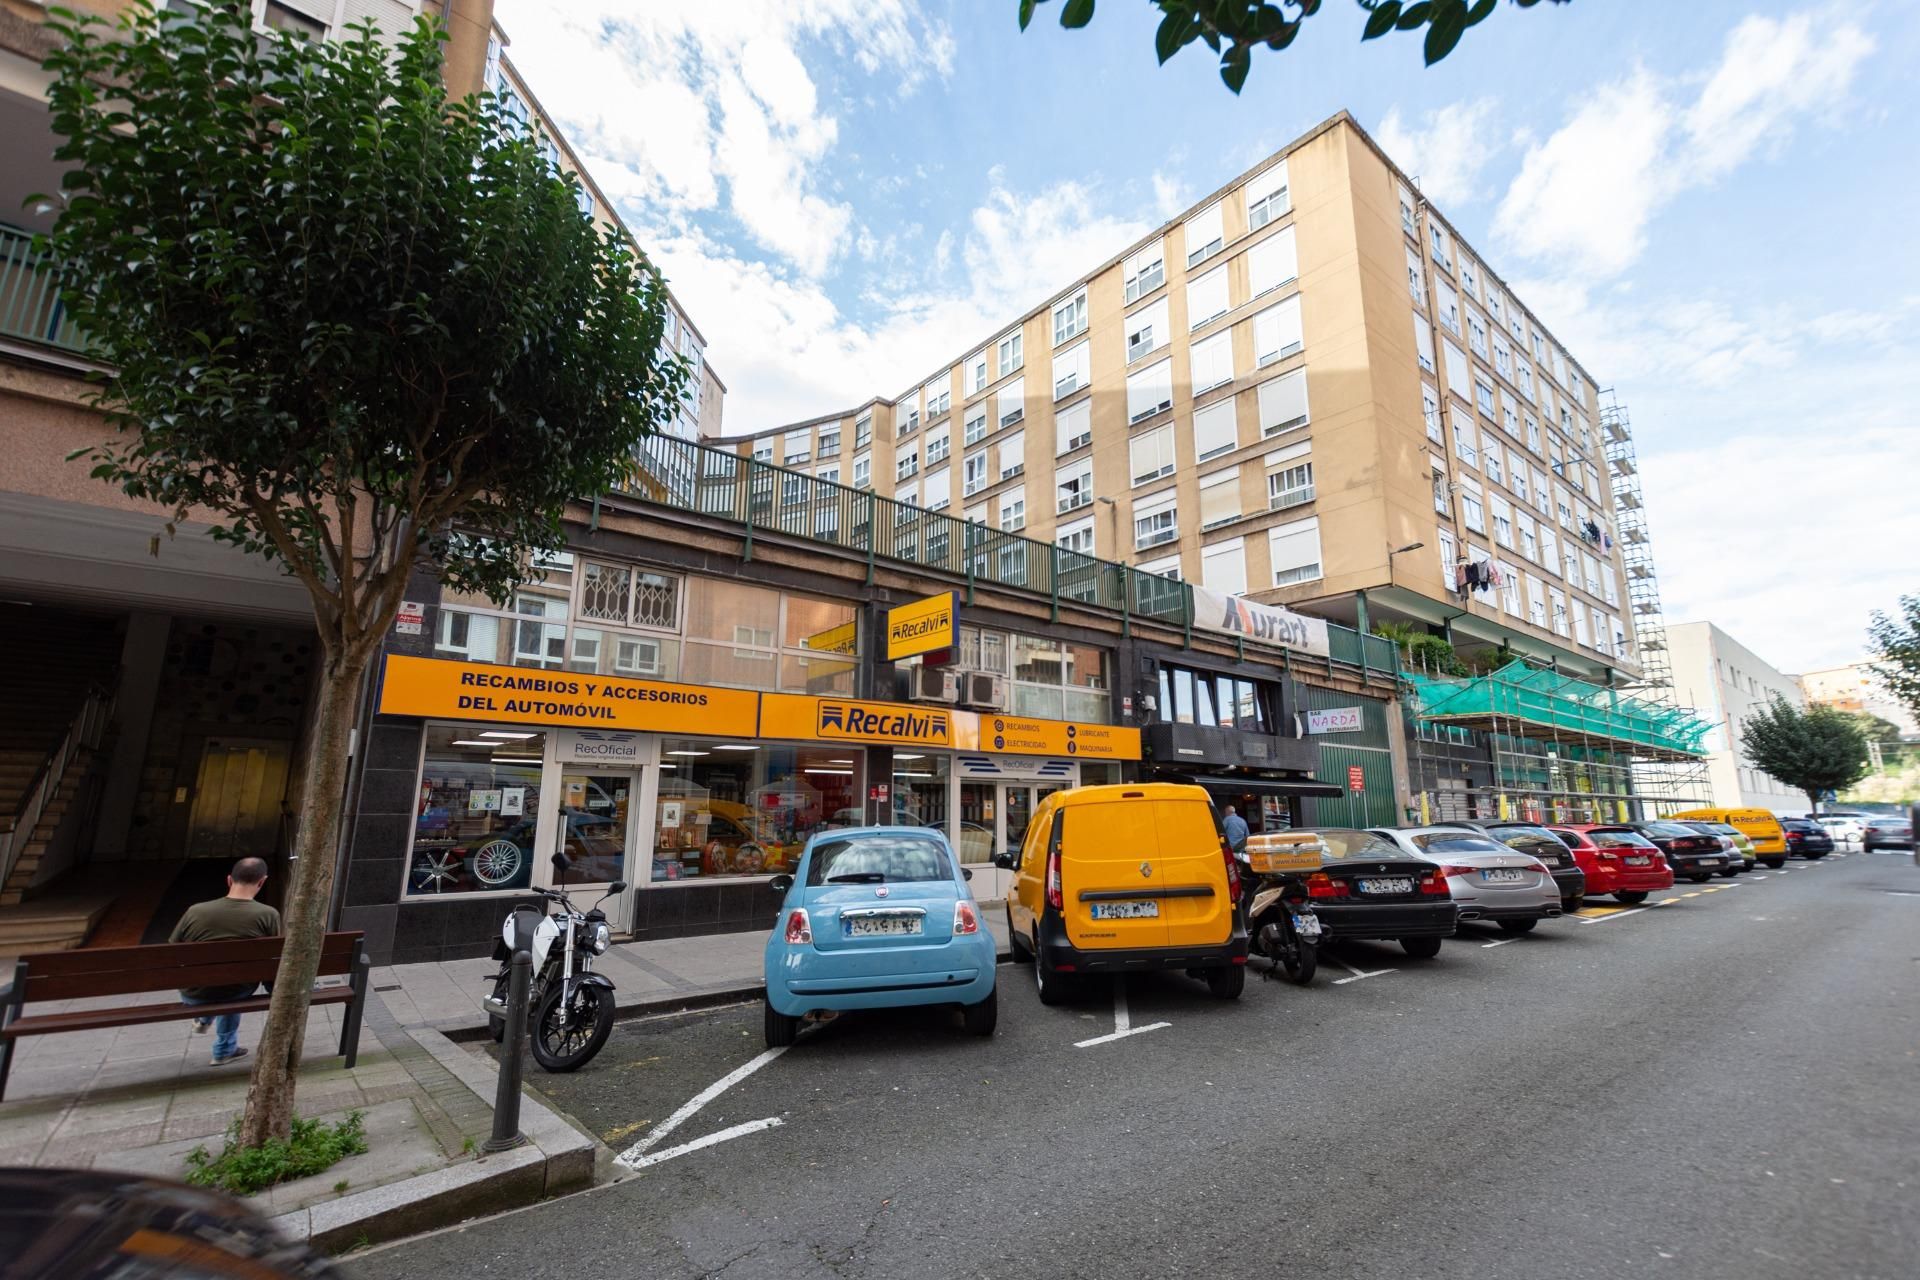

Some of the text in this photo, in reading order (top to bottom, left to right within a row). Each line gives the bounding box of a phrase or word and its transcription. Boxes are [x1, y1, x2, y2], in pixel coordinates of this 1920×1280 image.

[901, 614, 939, 639] Recalvi
[461, 672, 708, 706] RECAMBIOS Y ACCESORIOS
[458, 695, 616, 719] DEL AUTOMÓVIL
[845, 707, 930, 738] Recalvi
[1312, 714, 1357, 727] NARDA
[1006, 723, 1040, 732] RECAMBIOS
[575, 743, 636, 756] RecOficial
[1006, 740, 1046, 749] ELECTRICIDAD
[1080, 744, 1112, 752] MAQUINARIA
